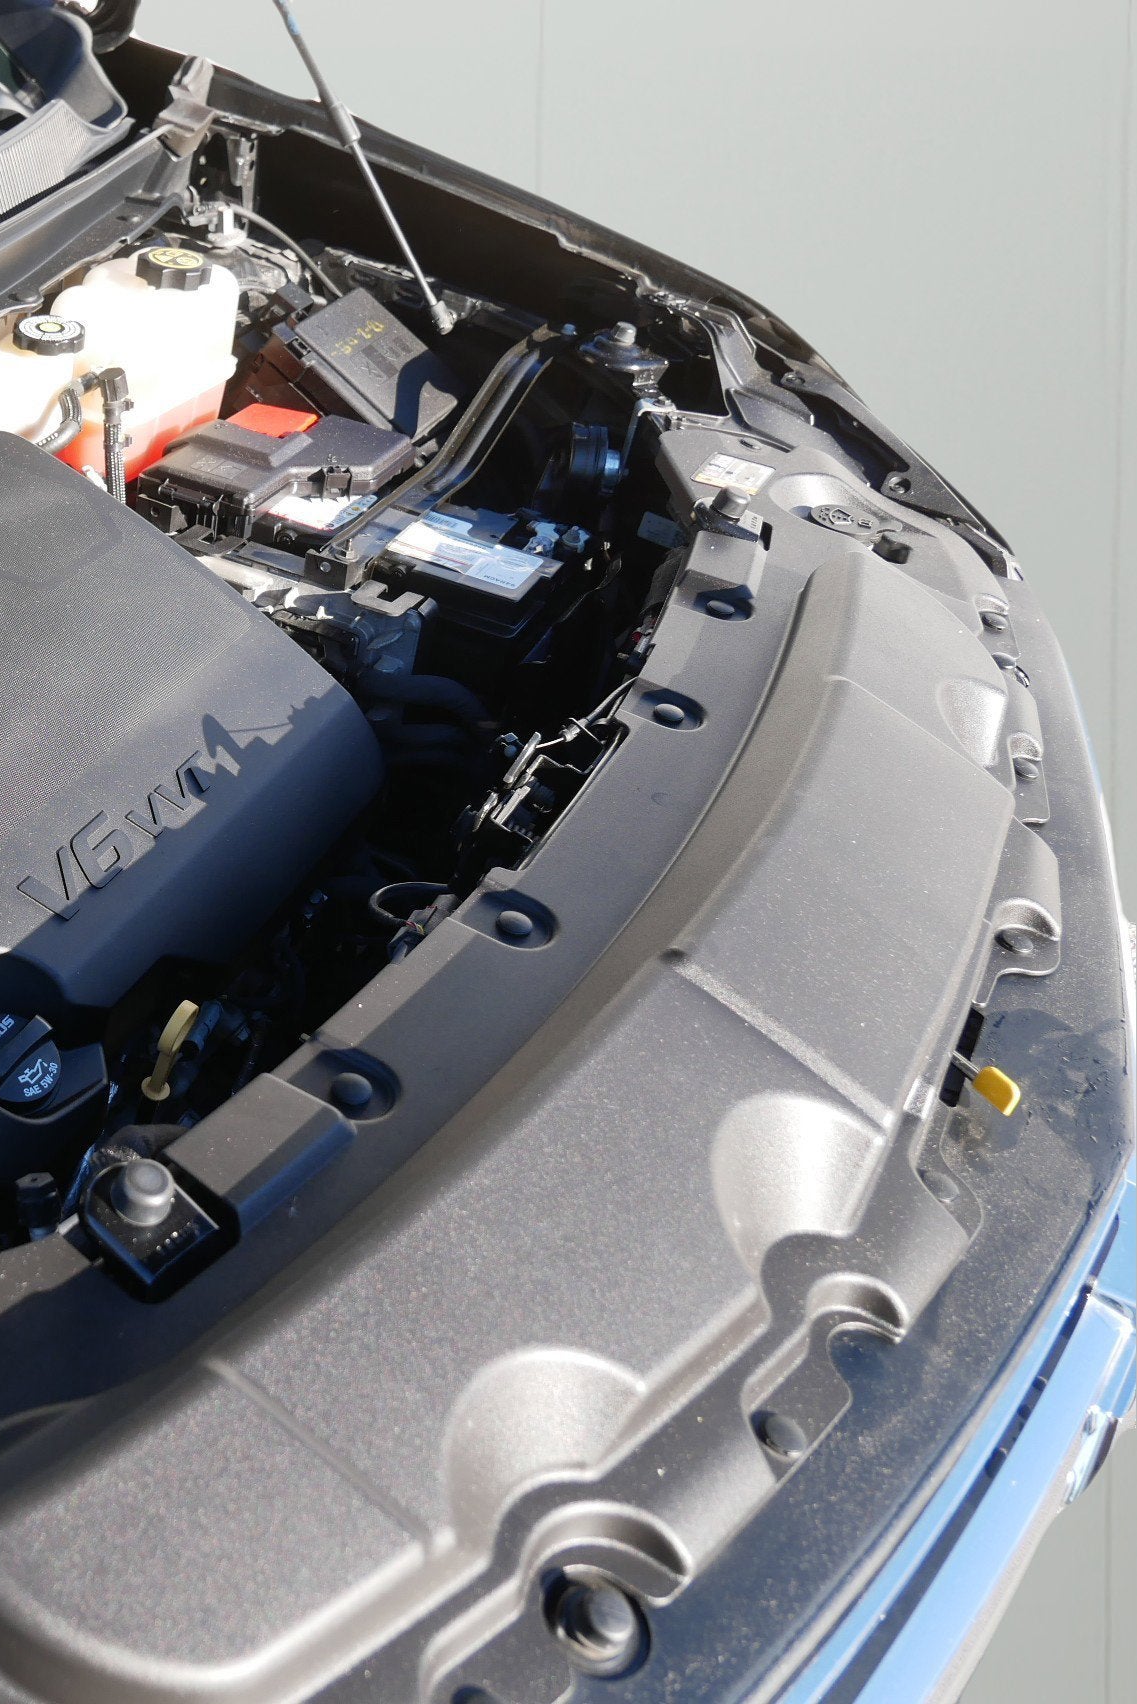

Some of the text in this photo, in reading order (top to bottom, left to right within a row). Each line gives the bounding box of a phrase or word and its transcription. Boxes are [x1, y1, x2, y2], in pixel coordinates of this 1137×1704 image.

[16, 810, 134, 921] V6
[23, 1062, 59, 1098] SAE 5W-30
